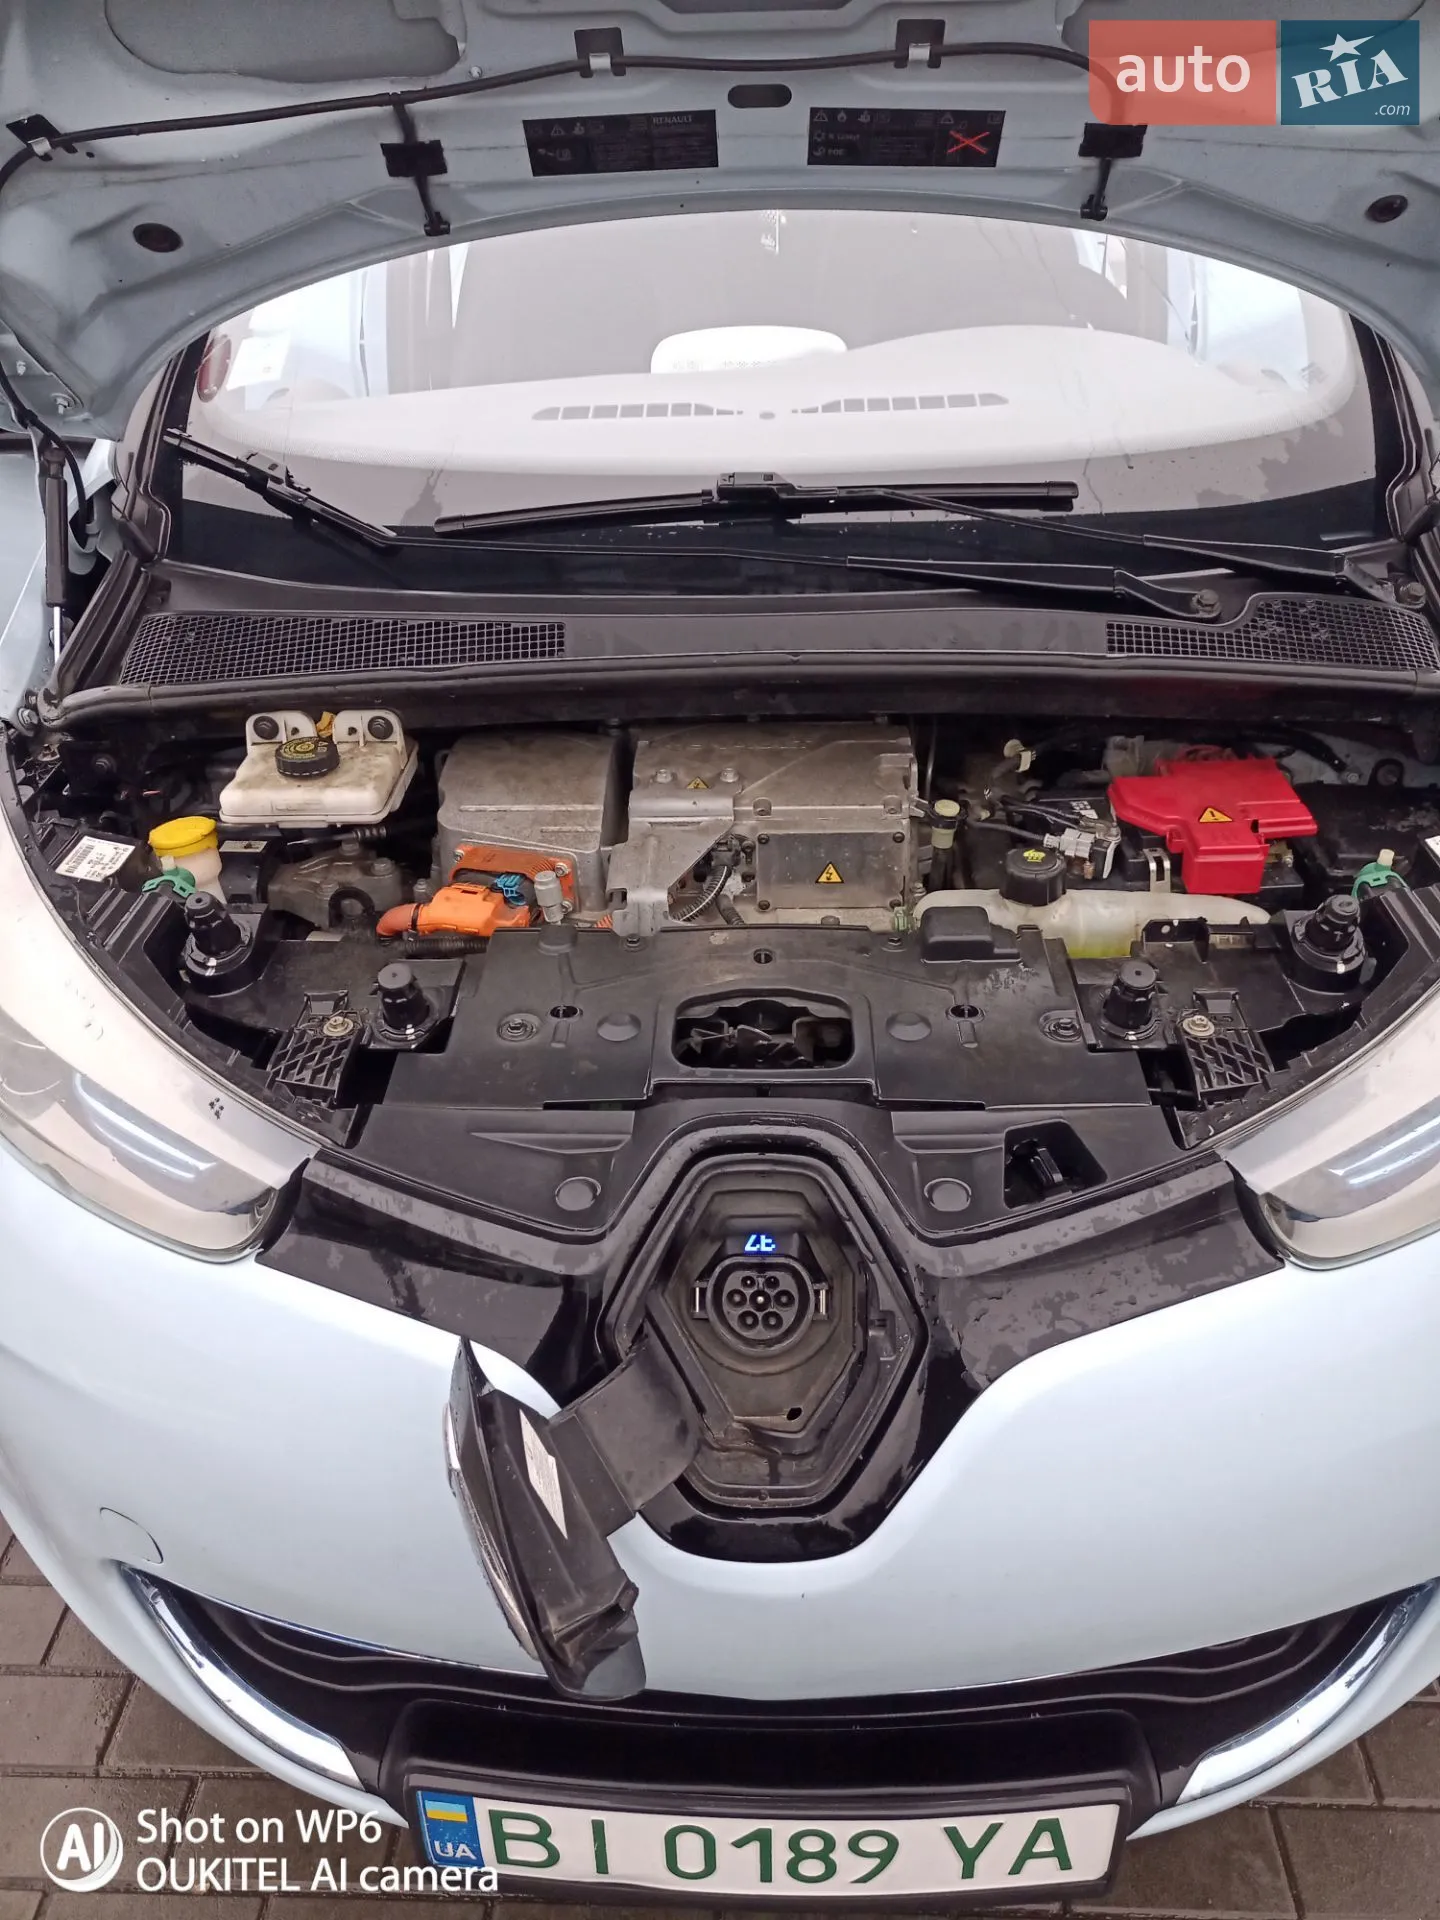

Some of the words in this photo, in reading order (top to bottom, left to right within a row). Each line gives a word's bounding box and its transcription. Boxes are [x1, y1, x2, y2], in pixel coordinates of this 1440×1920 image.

[434, 1840, 477, 1861] UA
[664, 1824, 899, 1885] 0189
[943, 1817, 1073, 1880] YA
